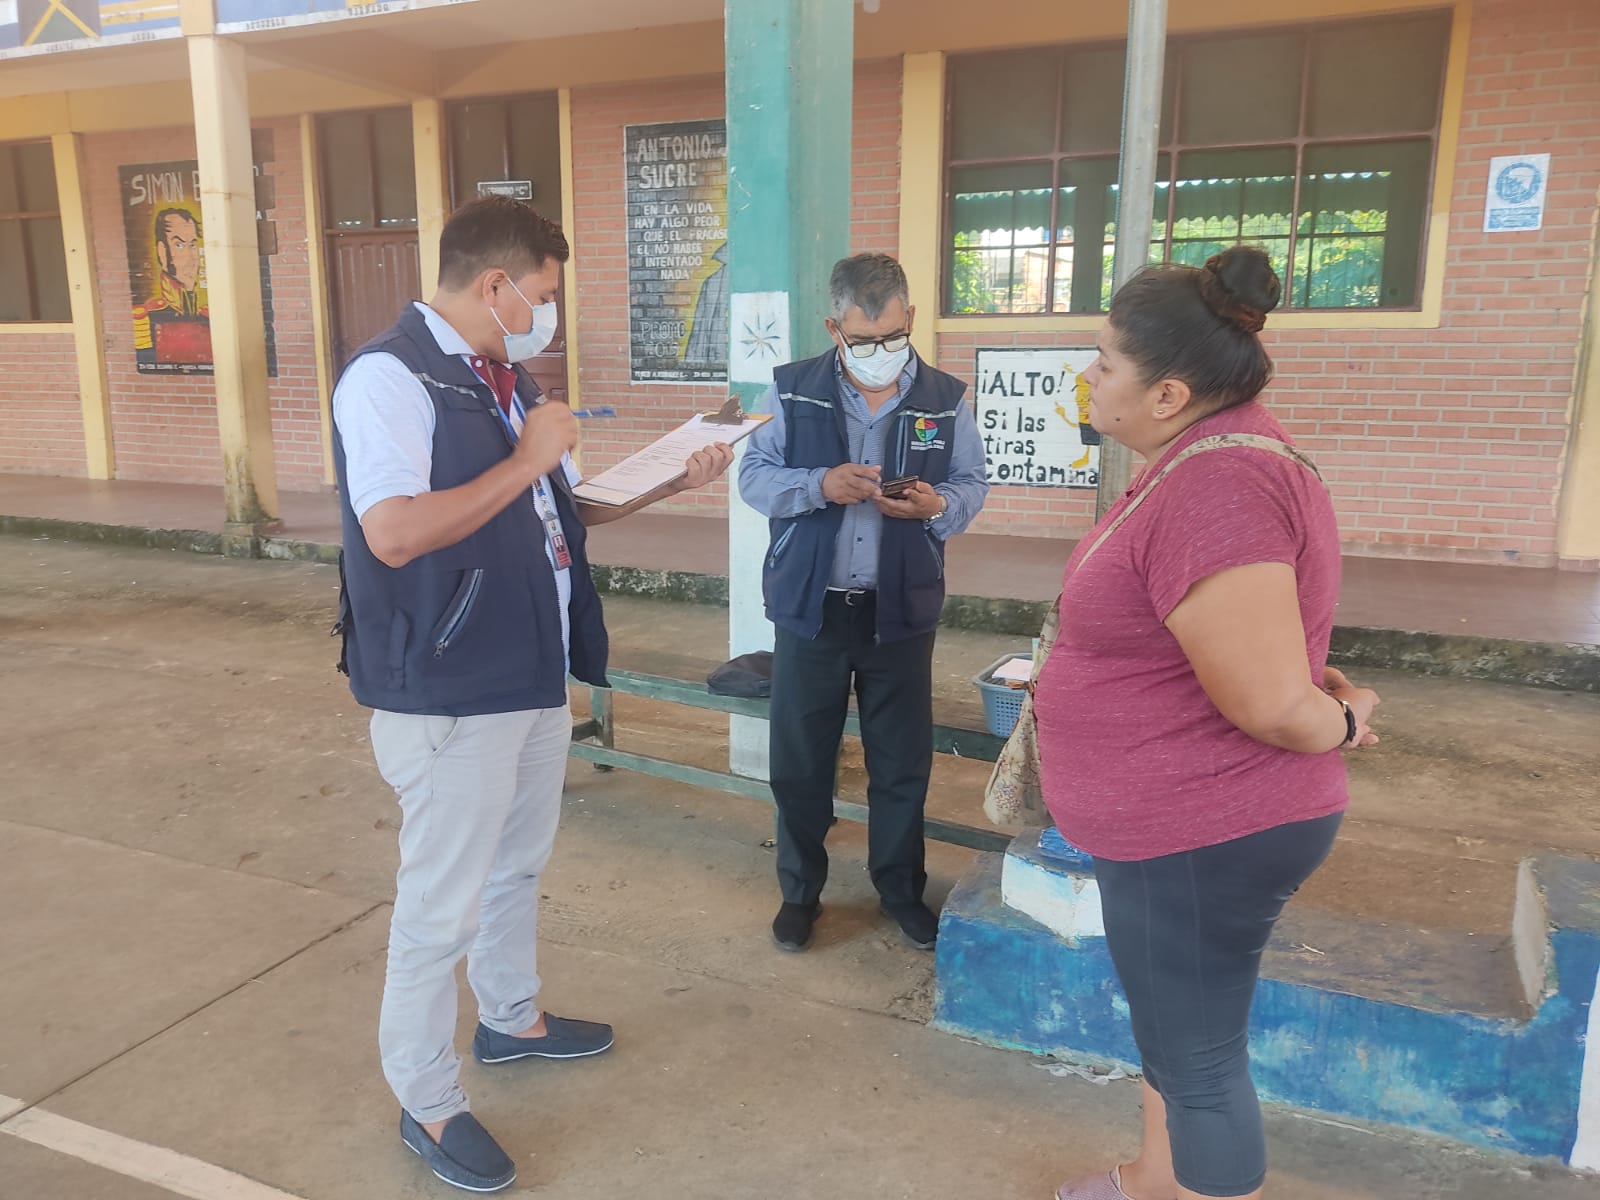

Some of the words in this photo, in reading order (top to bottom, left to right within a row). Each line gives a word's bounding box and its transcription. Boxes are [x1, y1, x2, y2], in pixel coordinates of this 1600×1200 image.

[635, 134, 711, 162] ANTONIO
[639, 162, 697, 189] SUCRE
[129, 171, 184, 206] SIMON
[643, 204, 658, 215] EN
[664, 204, 680, 214] LA
[686, 202, 713, 214] VIDA
[634, 217, 655, 229] HAY
[661, 216, 689, 228] ALGO
[694, 215, 720, 227] PEOR
[669, 230, 681, 241] EL
[637, 244, 649, 255] EL
[645, 255, 703, 268] INTENTADO
[660, 269, 690, 280] NADA
[981, 369, 1066, 397] ¡ALTO!
[983, 409, 1007, 430] Si
[1016, 407, 1046, 433] las
[983, 434, 1036, 456] tiras
